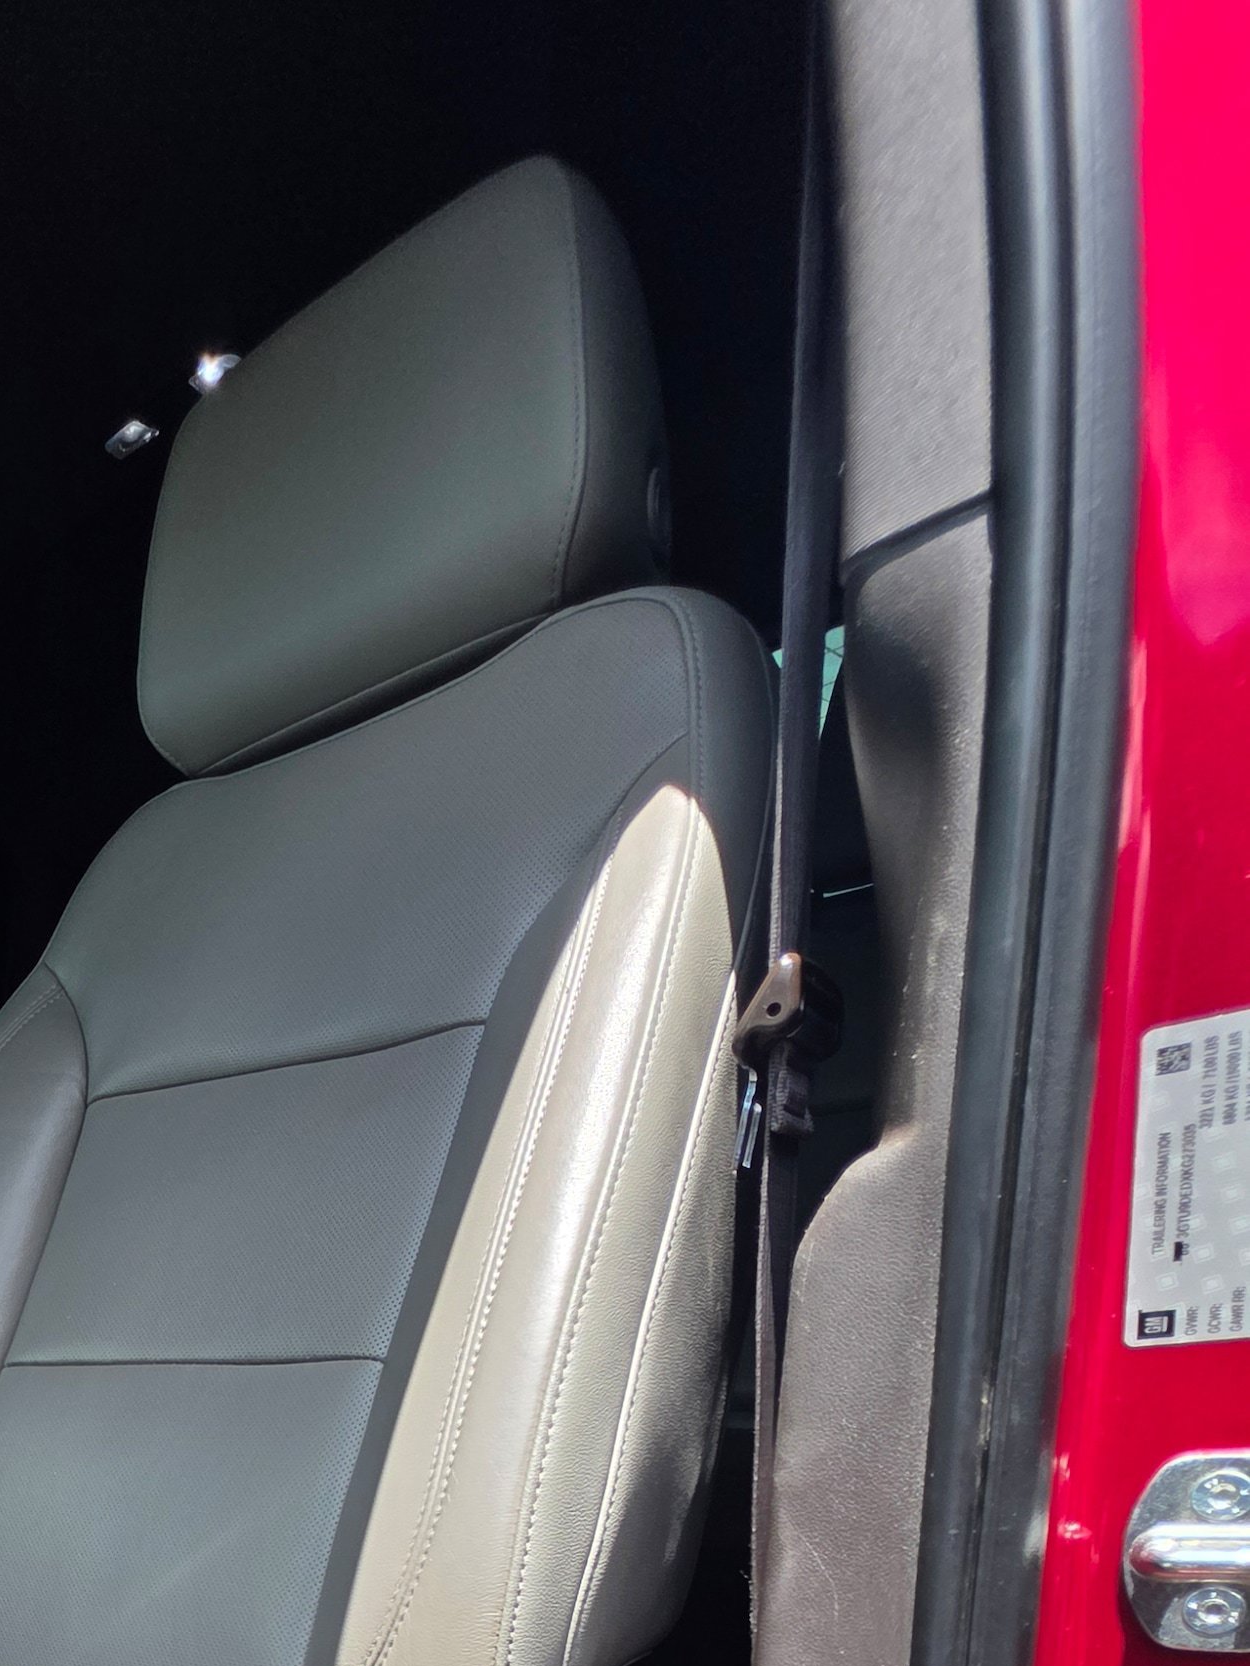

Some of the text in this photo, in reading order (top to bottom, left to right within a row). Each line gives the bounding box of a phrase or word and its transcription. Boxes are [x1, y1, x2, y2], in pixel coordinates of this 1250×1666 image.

[1152, 1132, 1171, 1255] TRAILERING INFORMATION
[1144, 1316, 1162, 1334] GM
[1229, 1304, 1245, 1331] GAWR
